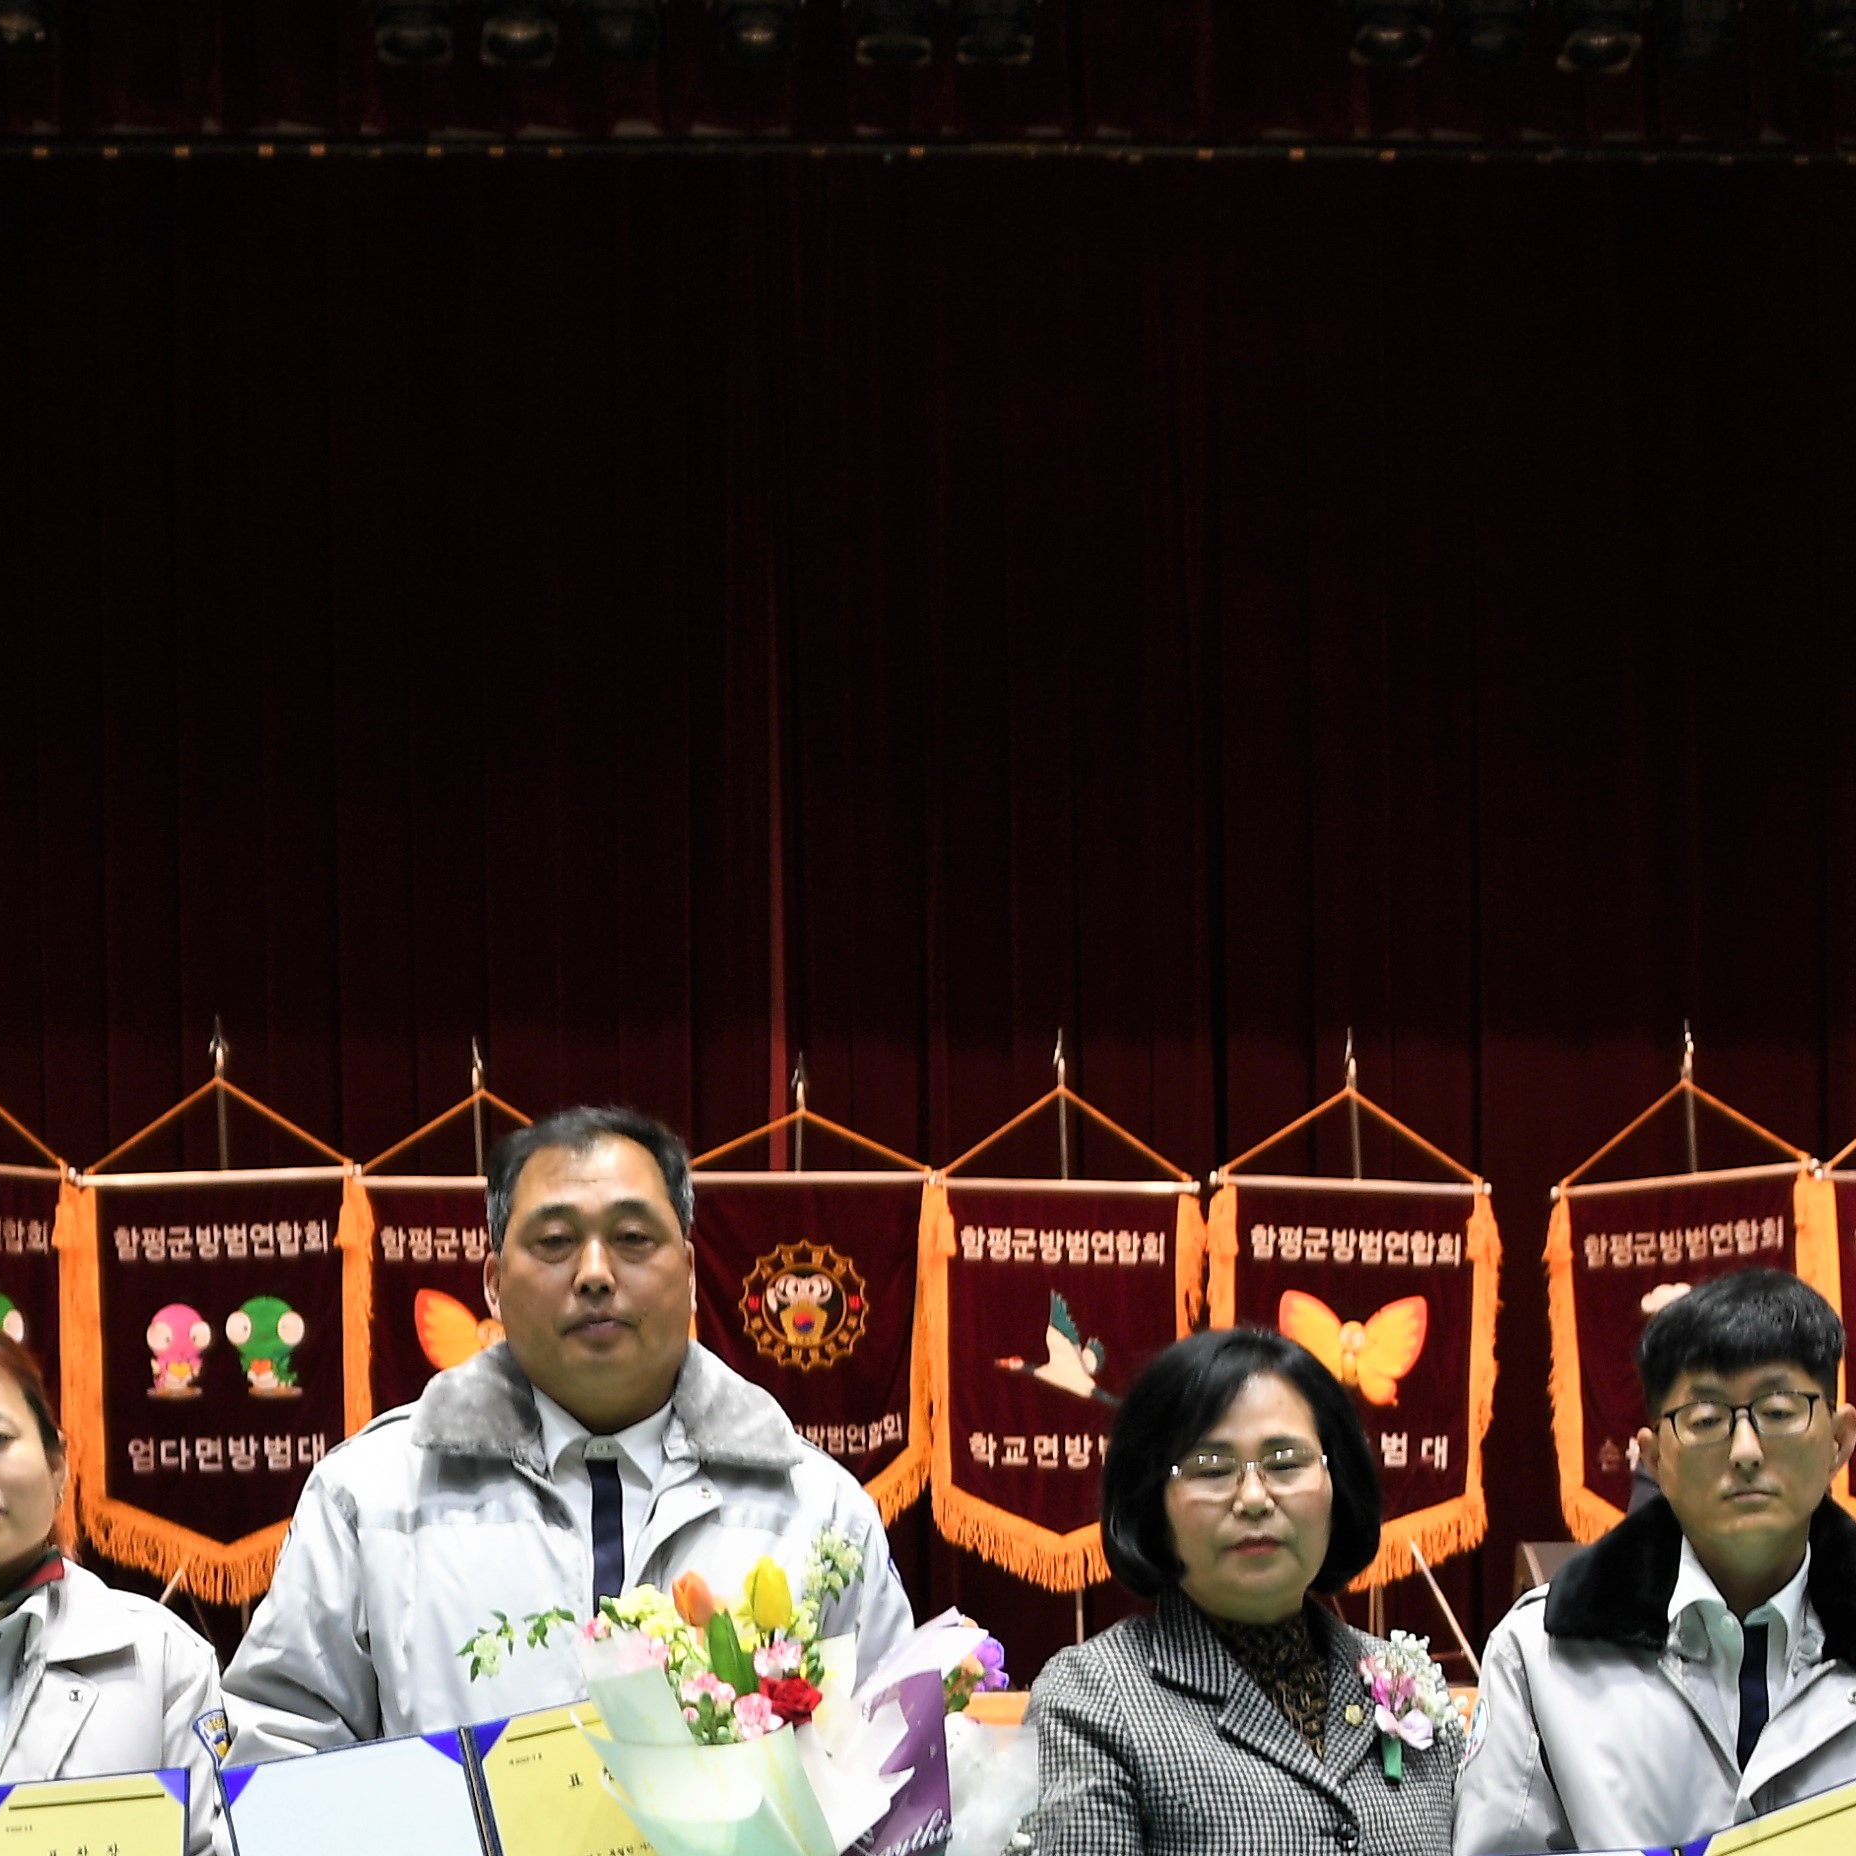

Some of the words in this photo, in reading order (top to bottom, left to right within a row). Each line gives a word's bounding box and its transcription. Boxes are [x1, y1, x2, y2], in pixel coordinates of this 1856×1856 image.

[114, 1220, 328, 1262] 함평군방범연합회
[381, 1225, 488, 1262] 함평군방
[960, 1226, 1165, 1266] 함평군방범연합회
[1250, 1225, 1461, 1267] 함평군방범연합회
[1584, 1217, 1784, 1268] 함평군방범연합회
[128, 1434, 326, 1472] 엄다면방범대
[969, 1432, 1108, 1467] 학교면방
[1380, 1432, 1449, 1470] 범대
